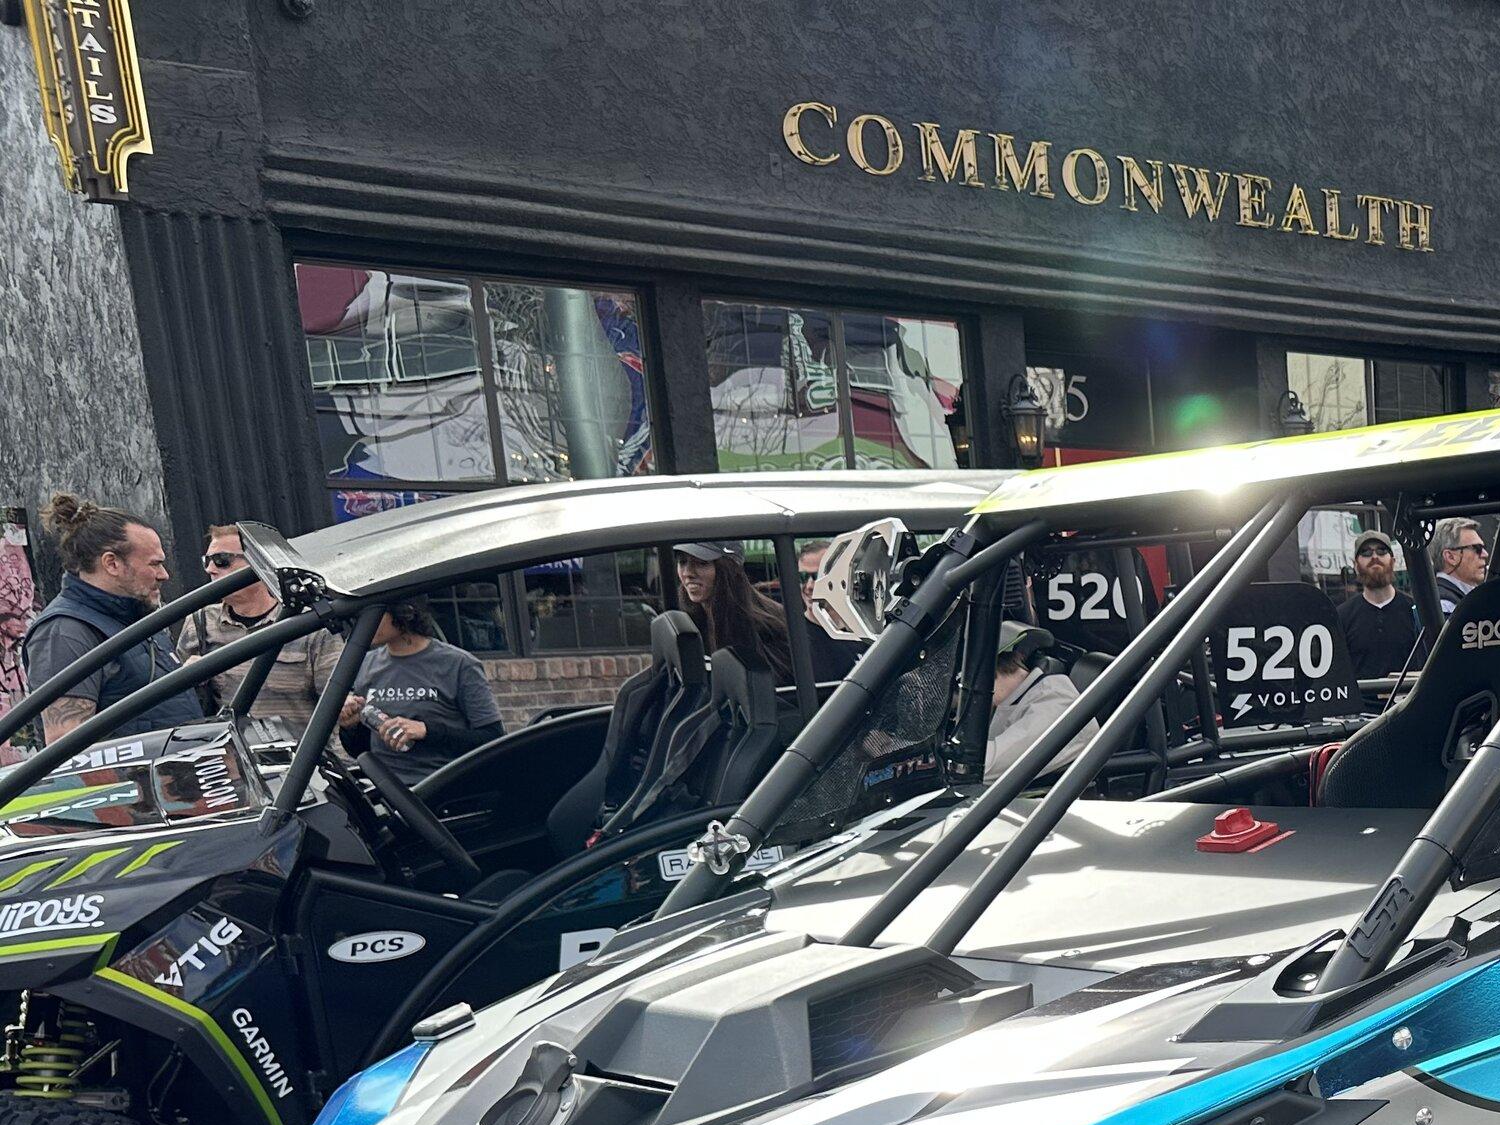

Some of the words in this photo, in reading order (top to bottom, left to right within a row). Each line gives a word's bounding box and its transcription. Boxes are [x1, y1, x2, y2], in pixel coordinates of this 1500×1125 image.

[72, 0, 118, 124] TAILS
[783, 102, 1434, 252] COMMONWEALTH
[1047, 573, 1143, 621] 520
[1226, 624, 1333, 682] 520
[378, 687, 438, 698] VOLCON
[1258, 687, 1348, 707] VOLCON
[195, 756, 239, 808] VOLCON
[350, 937, 404, 956] PCS
[231, 1007, 293, 1098] GARMIN
